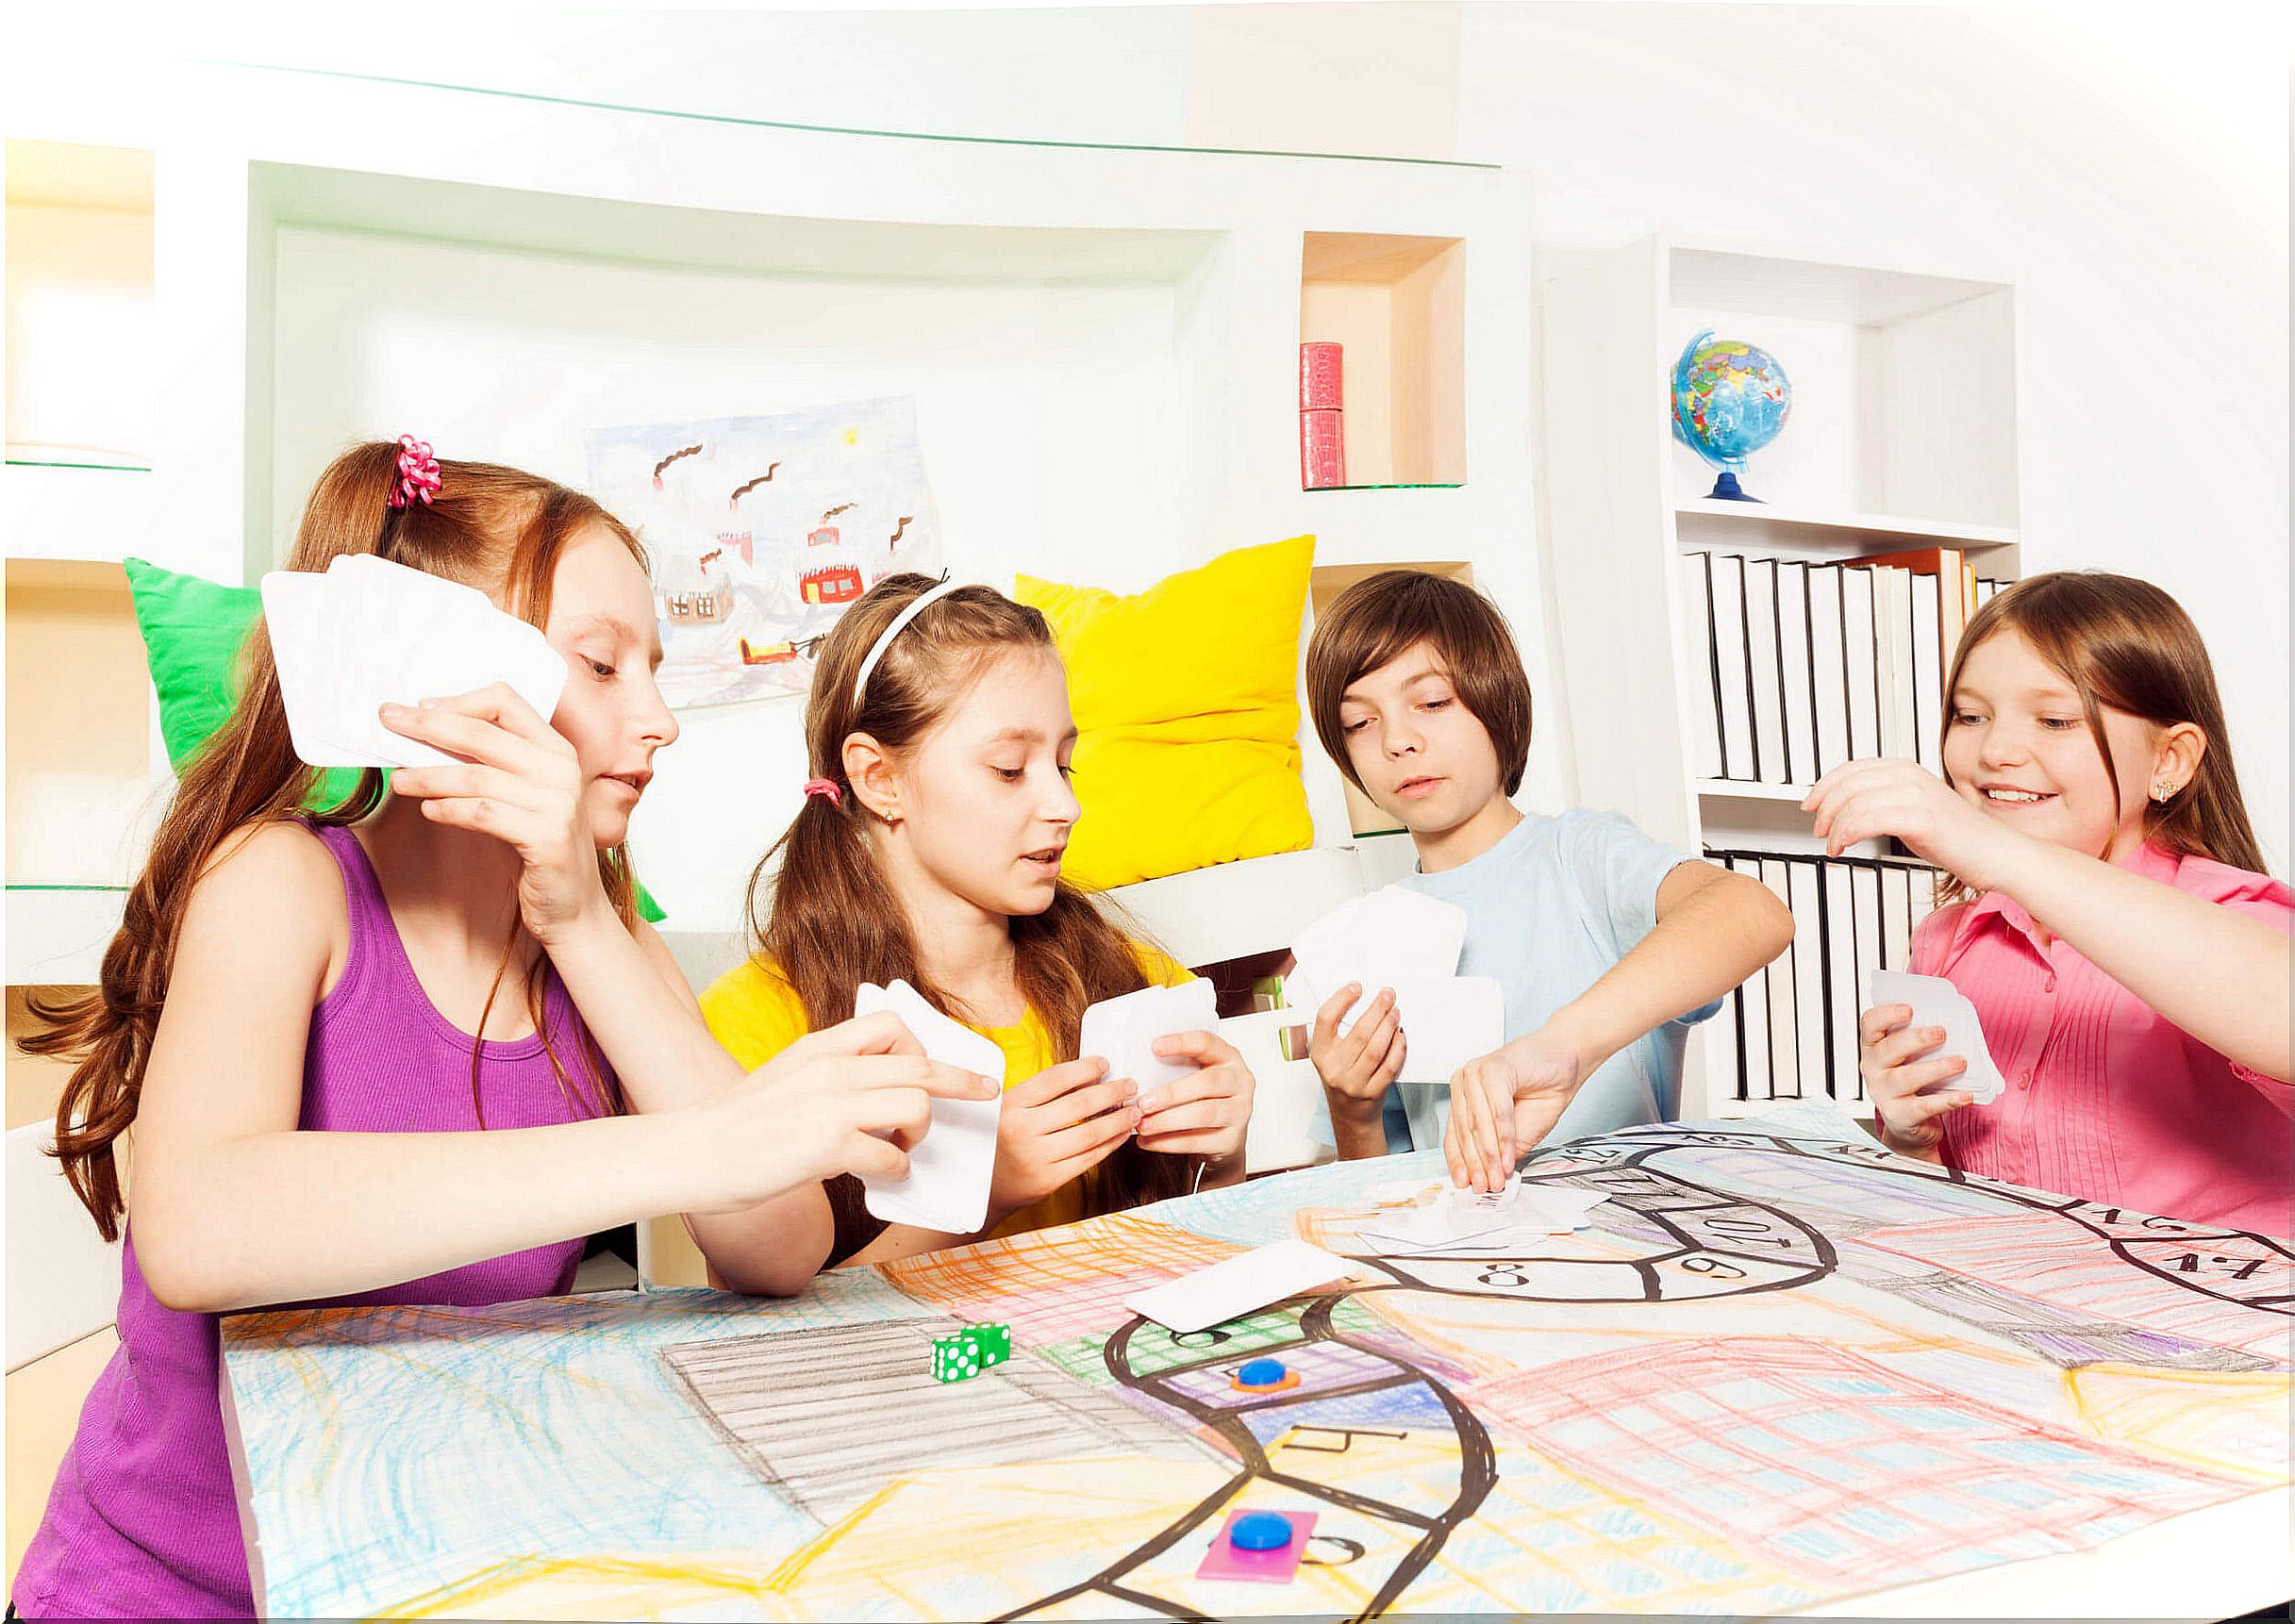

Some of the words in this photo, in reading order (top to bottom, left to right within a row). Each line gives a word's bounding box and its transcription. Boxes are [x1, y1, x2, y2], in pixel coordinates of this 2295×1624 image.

[1681, 1135, 1755, 1146] 13
[1559, 1148, 1621, 1165] 12
[1703, 1218, 1792, 1249] 10
[1476, 1264, 1530, 1287] 8
[1680, 1257, 1747, 1279] 9
[2163, 1252, 2270, 1281] 17
